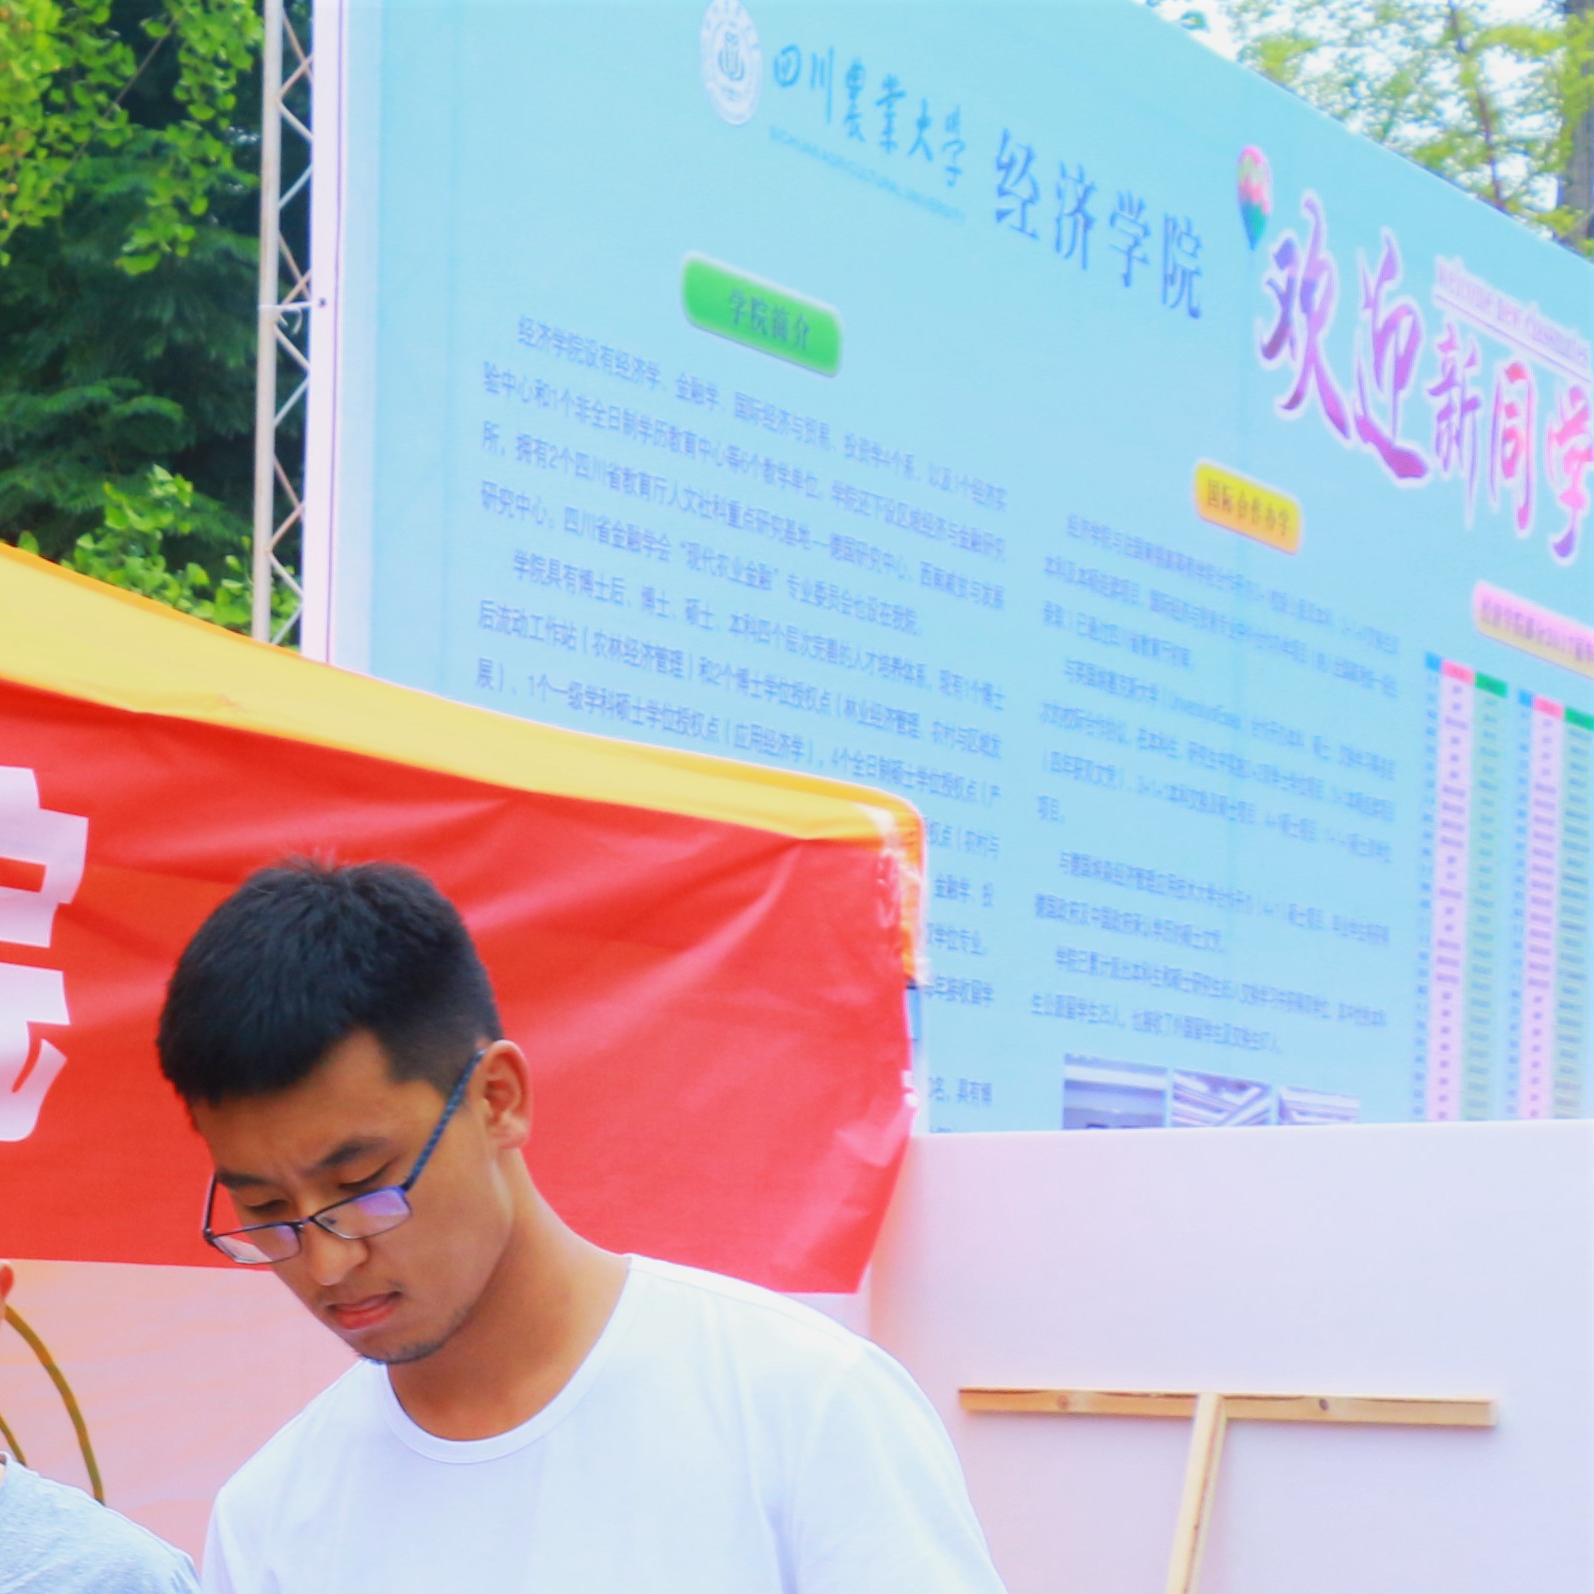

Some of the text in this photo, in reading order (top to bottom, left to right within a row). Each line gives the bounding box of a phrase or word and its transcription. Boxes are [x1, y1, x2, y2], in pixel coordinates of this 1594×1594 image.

[728, 287, 811, 350] 学院简介
[994, 127, 1202, 320] 经济学院
[1257, 192, 1594, 563] 欢迎新同学
